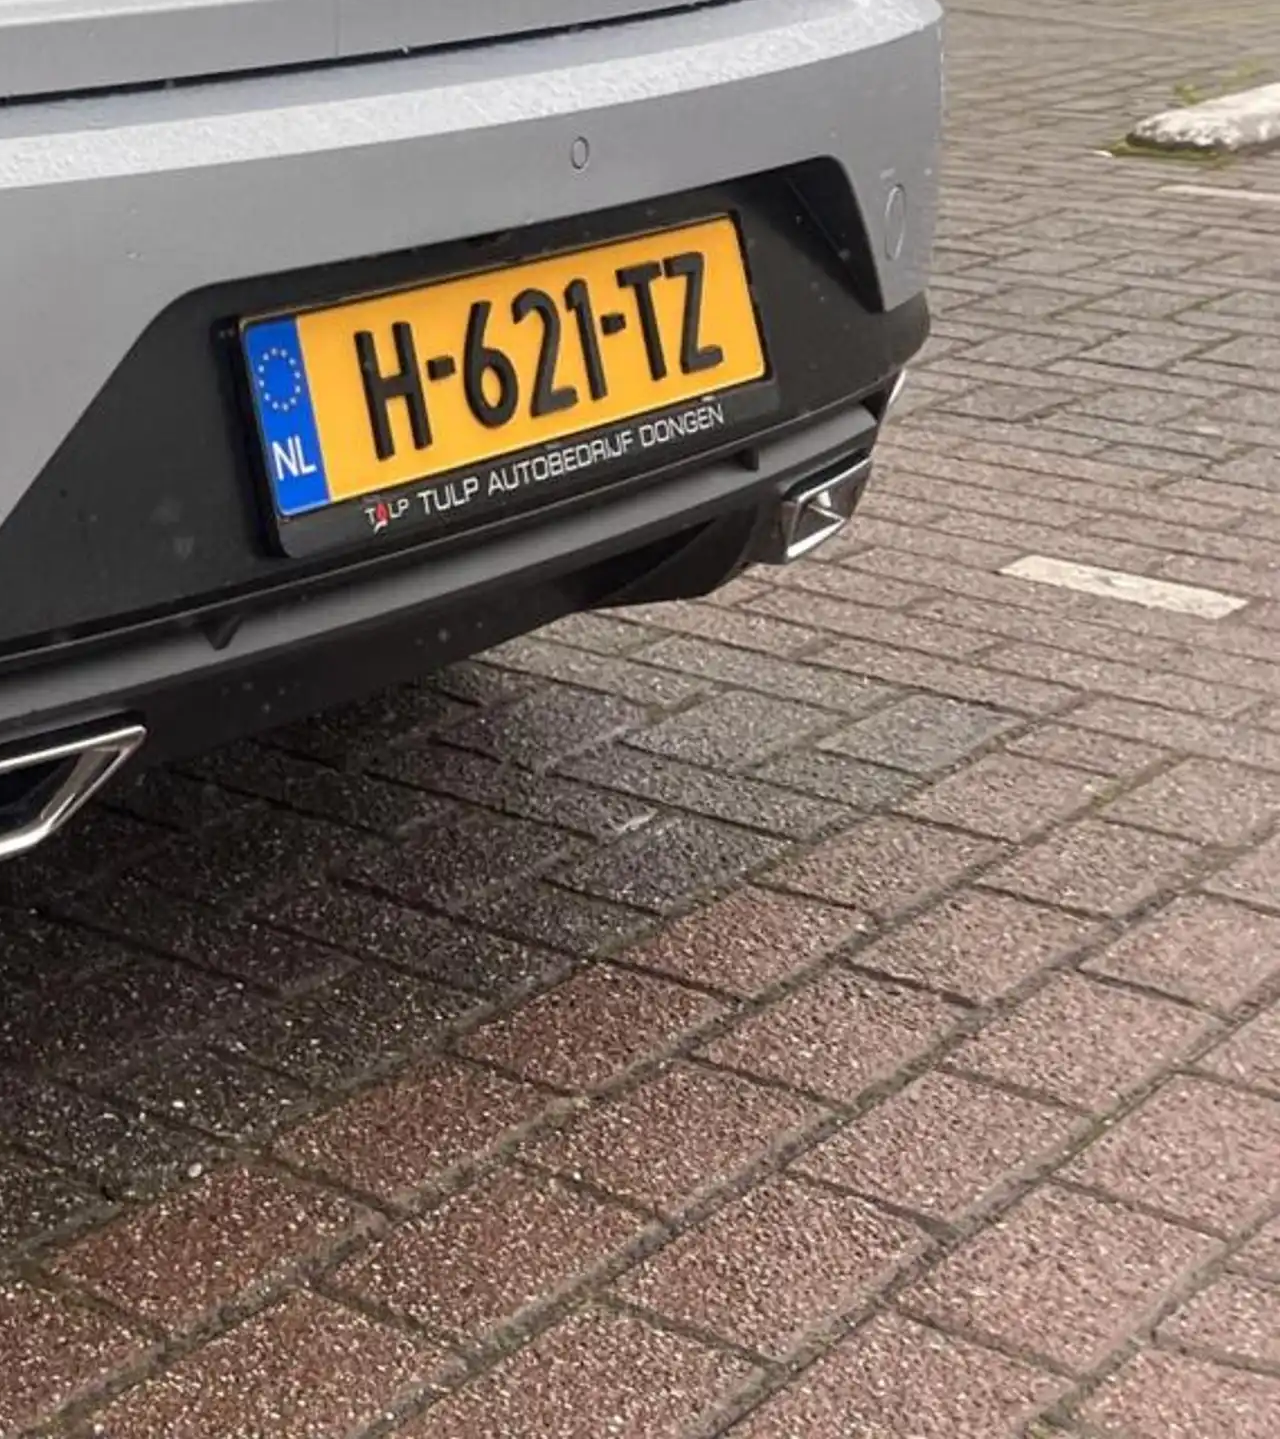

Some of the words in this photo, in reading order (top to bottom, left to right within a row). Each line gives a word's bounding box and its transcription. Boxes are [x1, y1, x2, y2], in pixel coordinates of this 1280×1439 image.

[353, 251, 724, 461] H-621-TZ
[271, 434, 318, 482] NL
[416, 475, 480, 515] TULP
[487, 429, 634, 497] AUTOBEDRIJF
[639, 402, 725, 449] DONGEN
